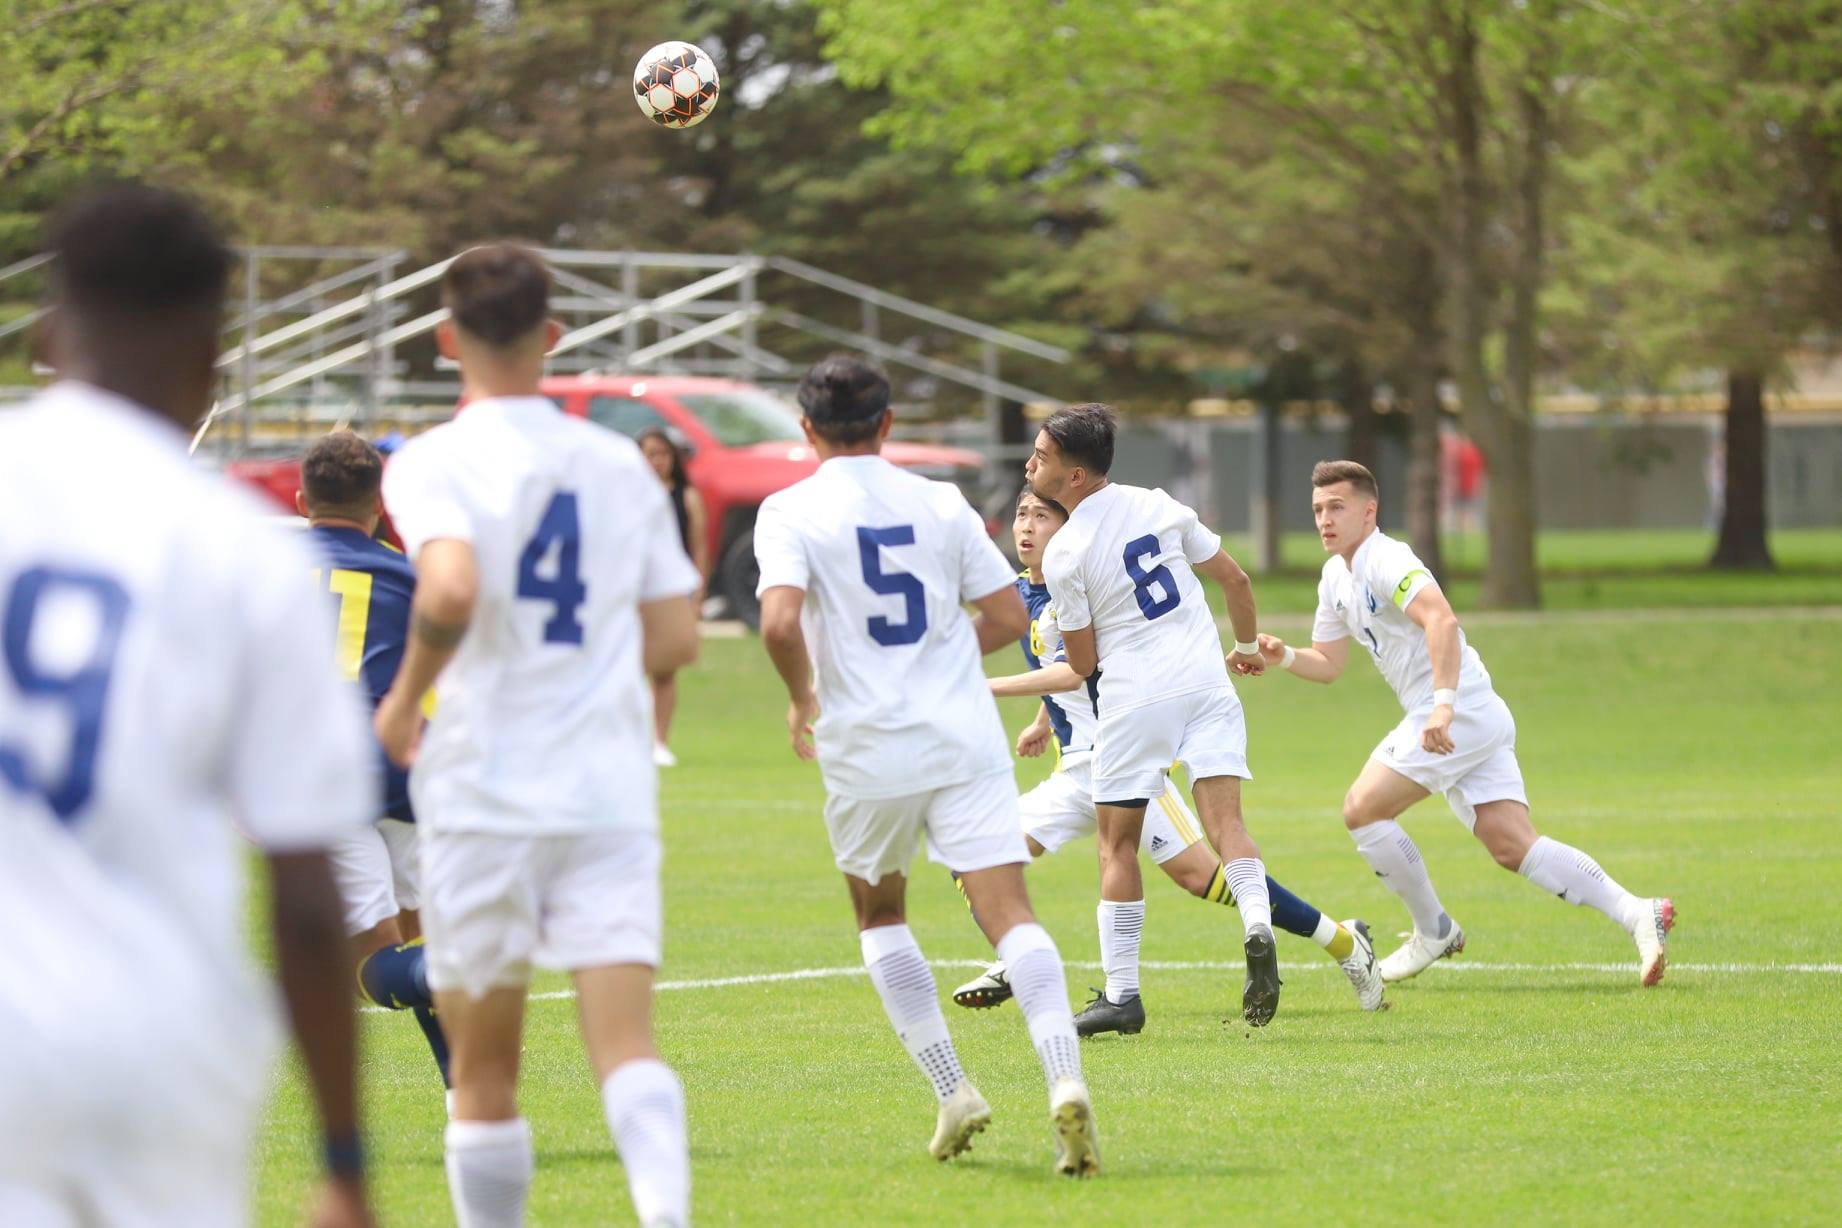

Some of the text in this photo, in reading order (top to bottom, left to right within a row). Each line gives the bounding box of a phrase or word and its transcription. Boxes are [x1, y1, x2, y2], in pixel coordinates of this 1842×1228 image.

[517, 491, 587, 643] 4
[857, 524, 927, 646] 5
[1123, 534, 1181, 620] 6
[0, 566, 131, 818] 9
